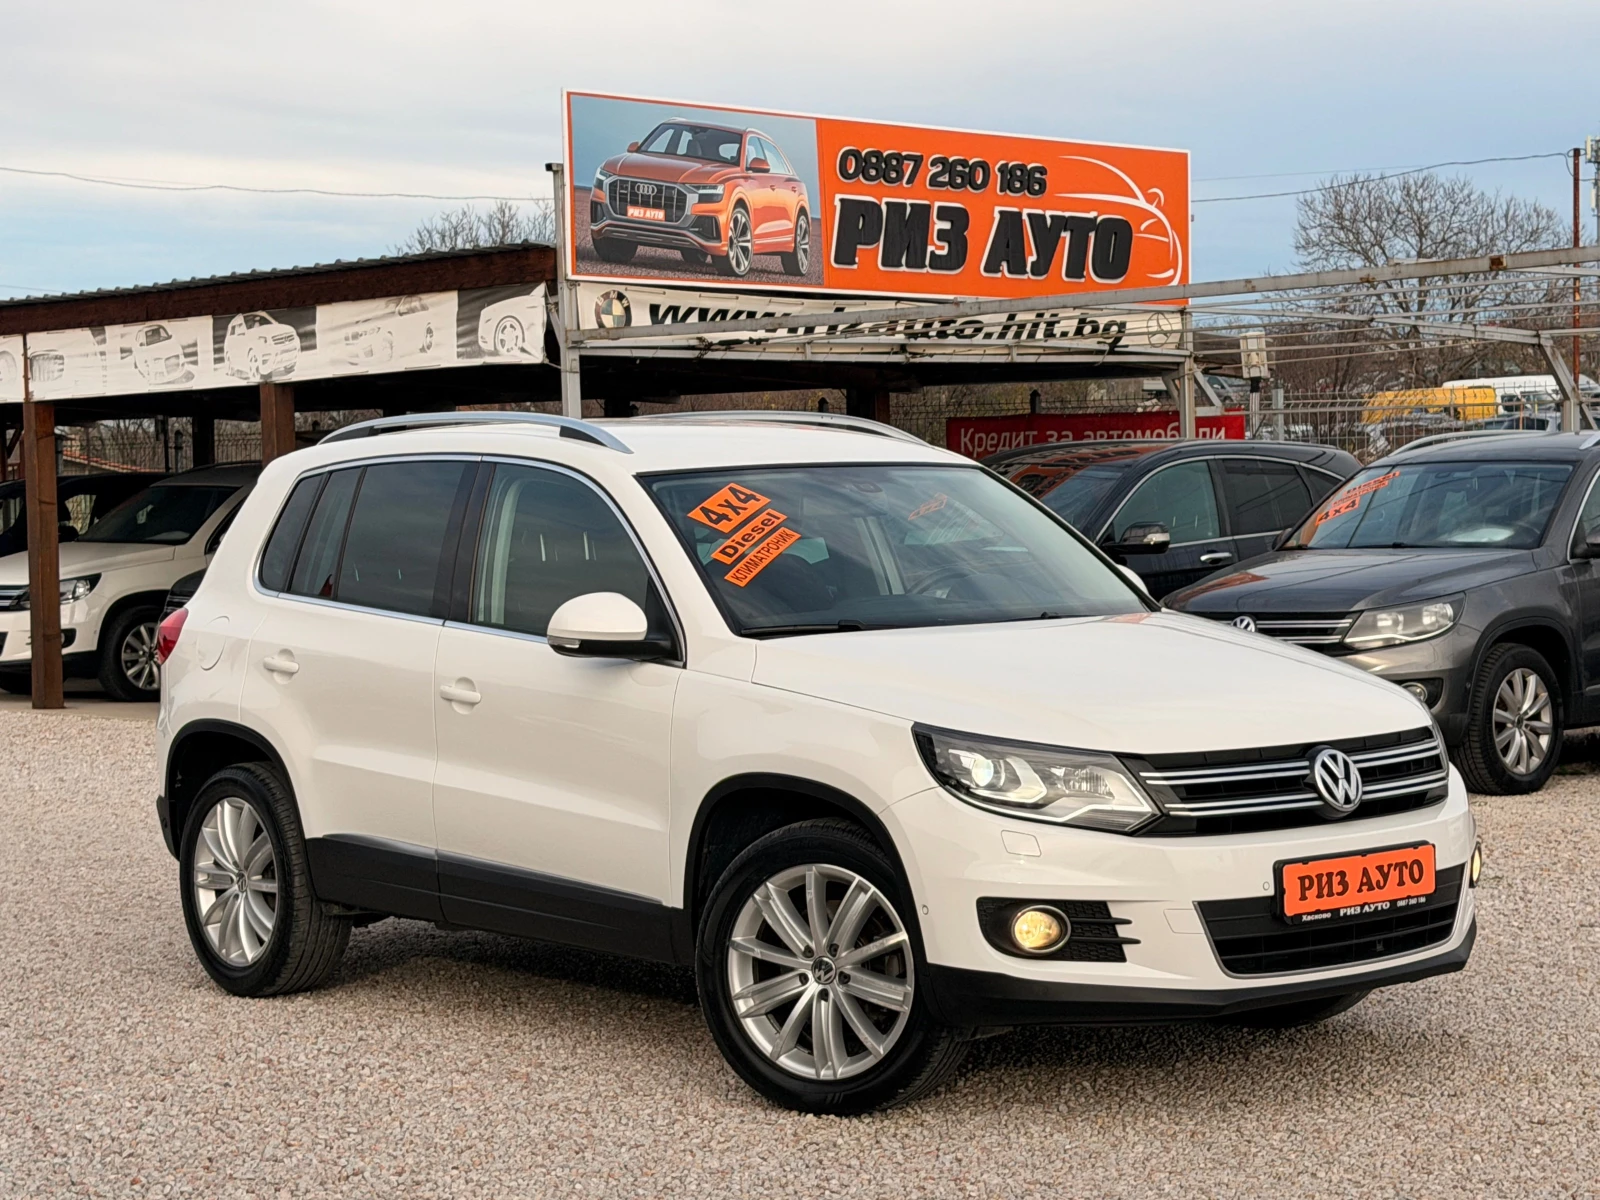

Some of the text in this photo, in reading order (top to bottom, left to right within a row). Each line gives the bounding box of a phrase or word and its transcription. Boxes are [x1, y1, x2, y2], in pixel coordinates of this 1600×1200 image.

[838, 147, 1048, 198] 0887 260 186
[628, 207, 665, 219] РИЗ АУТО
[831, 194, 1134, 283] РИЗ АУТО
[960, 428, 1038, 454] Кредит
[719, 512, 781, 558] Diesel
[730, 530, 795, 583] КЛИМАТРОНИК
[1298, 859, 1424, 901] РИЗ АУТО
[1302, 912, 1332, 922] Хасково
[1340, 906, 1360, 917] РИЗ
[1362, 901, 1391, 914] АУТО
